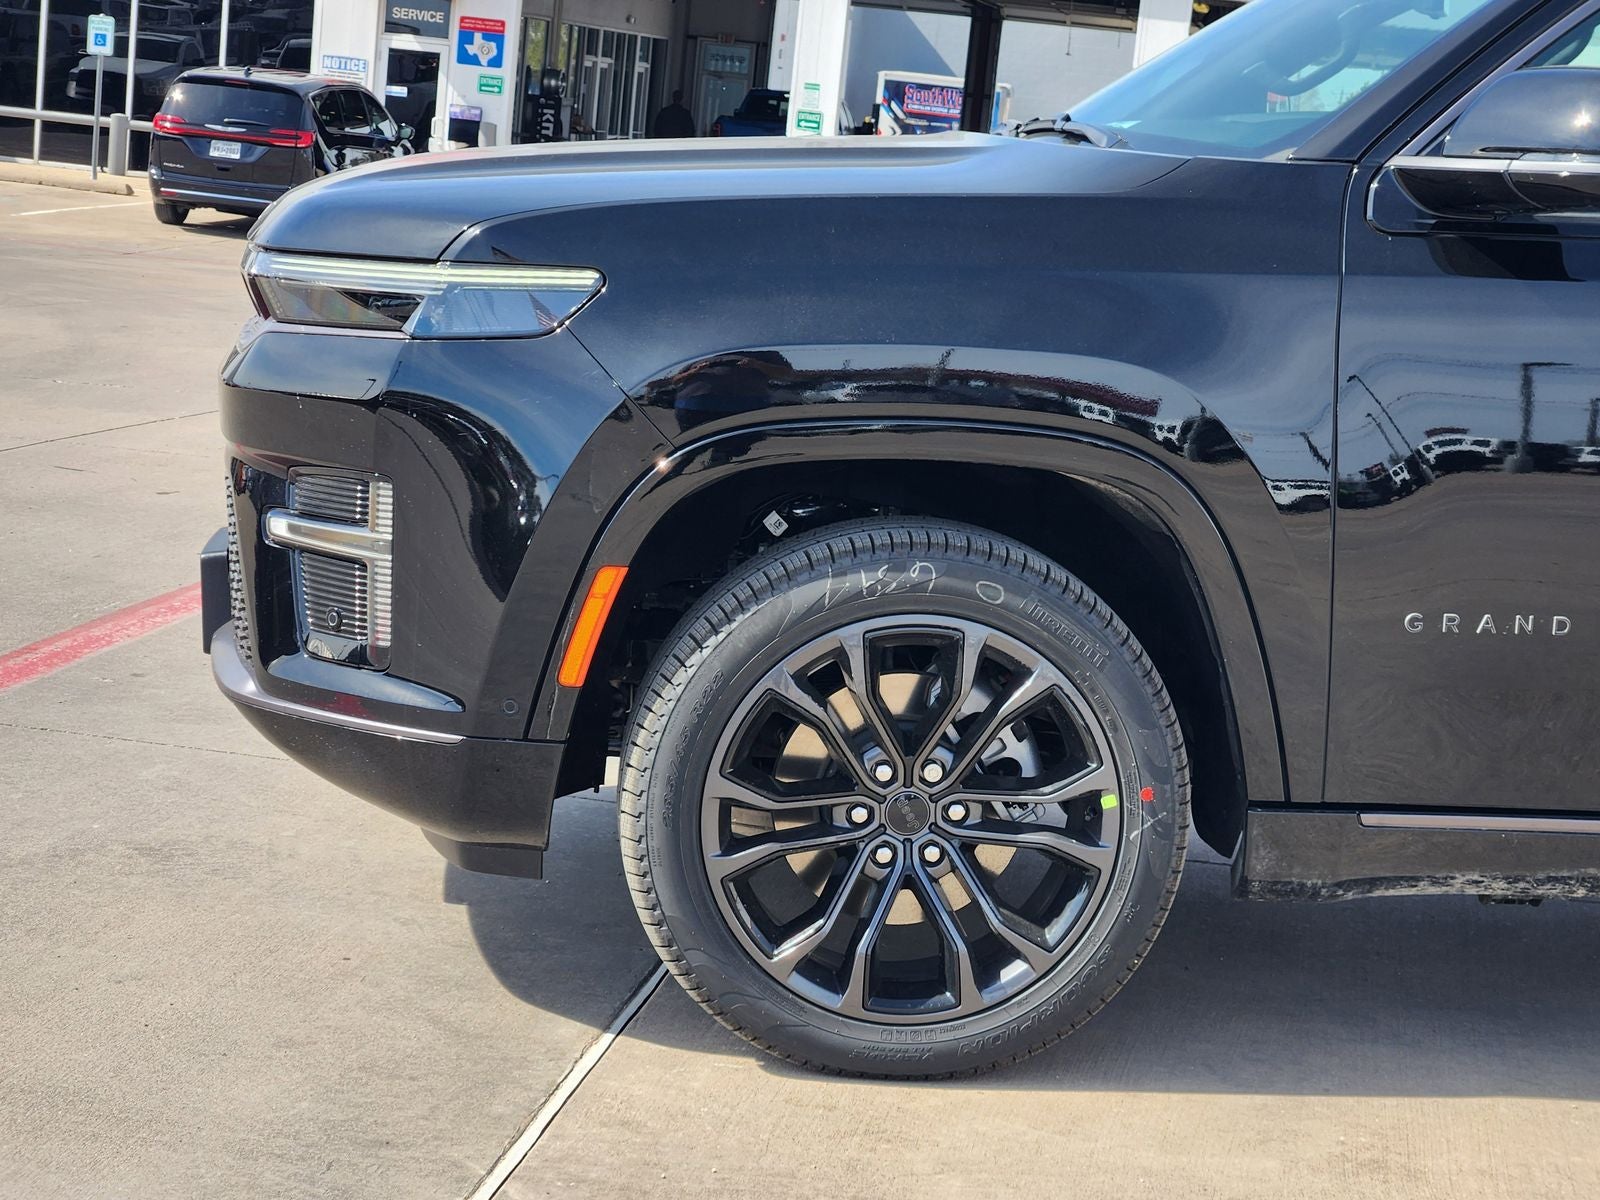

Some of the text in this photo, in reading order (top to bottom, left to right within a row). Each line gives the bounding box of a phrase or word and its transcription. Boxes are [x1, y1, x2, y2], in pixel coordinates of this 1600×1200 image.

[391, 7, 445, 23] SERVICE
[323, 56, 366, 71] NOTICE
[480, 77, 502, 86] ENTRANCE
[798, 113, 821, 122] ENTRANCE
[1404, 612, 1572, 636] GRAND
